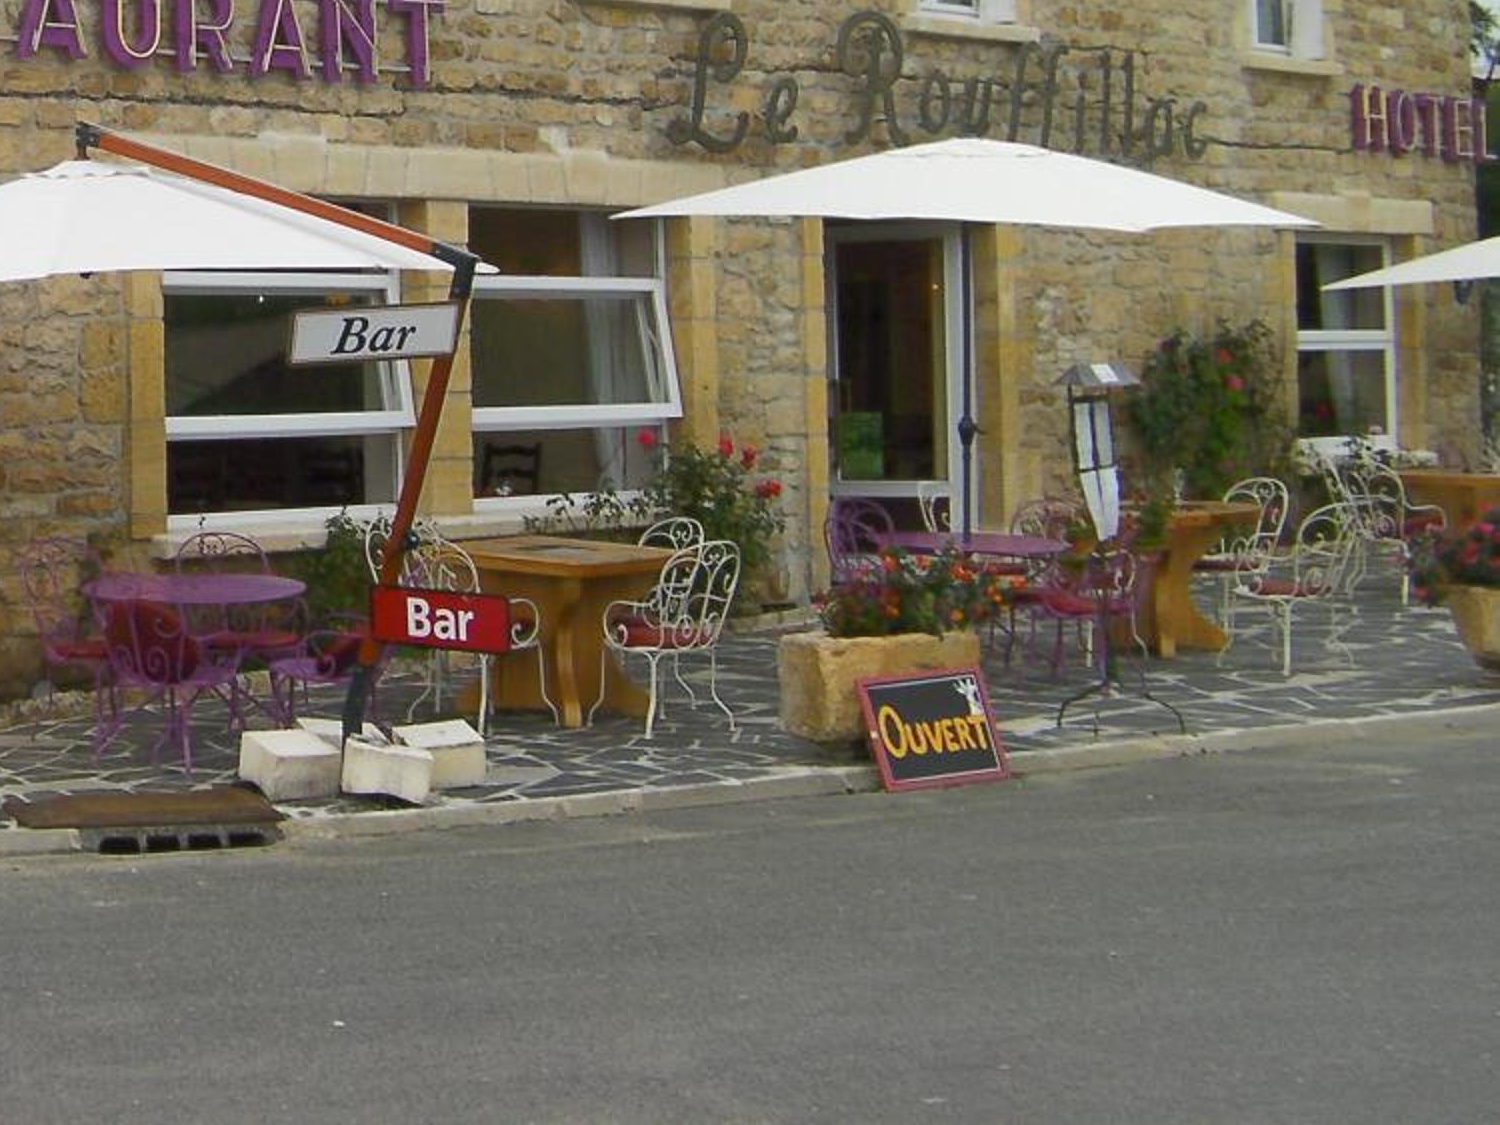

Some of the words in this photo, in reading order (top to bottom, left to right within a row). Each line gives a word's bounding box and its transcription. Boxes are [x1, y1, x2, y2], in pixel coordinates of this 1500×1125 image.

[665, 11, 798, 153] Le
[1351, 82, 1499, 163] HOTEL
[330, 316, 417, 354] Bar
[406, 597, 475, 642] Bar
[878, 705, 988, 759] OUVERT
